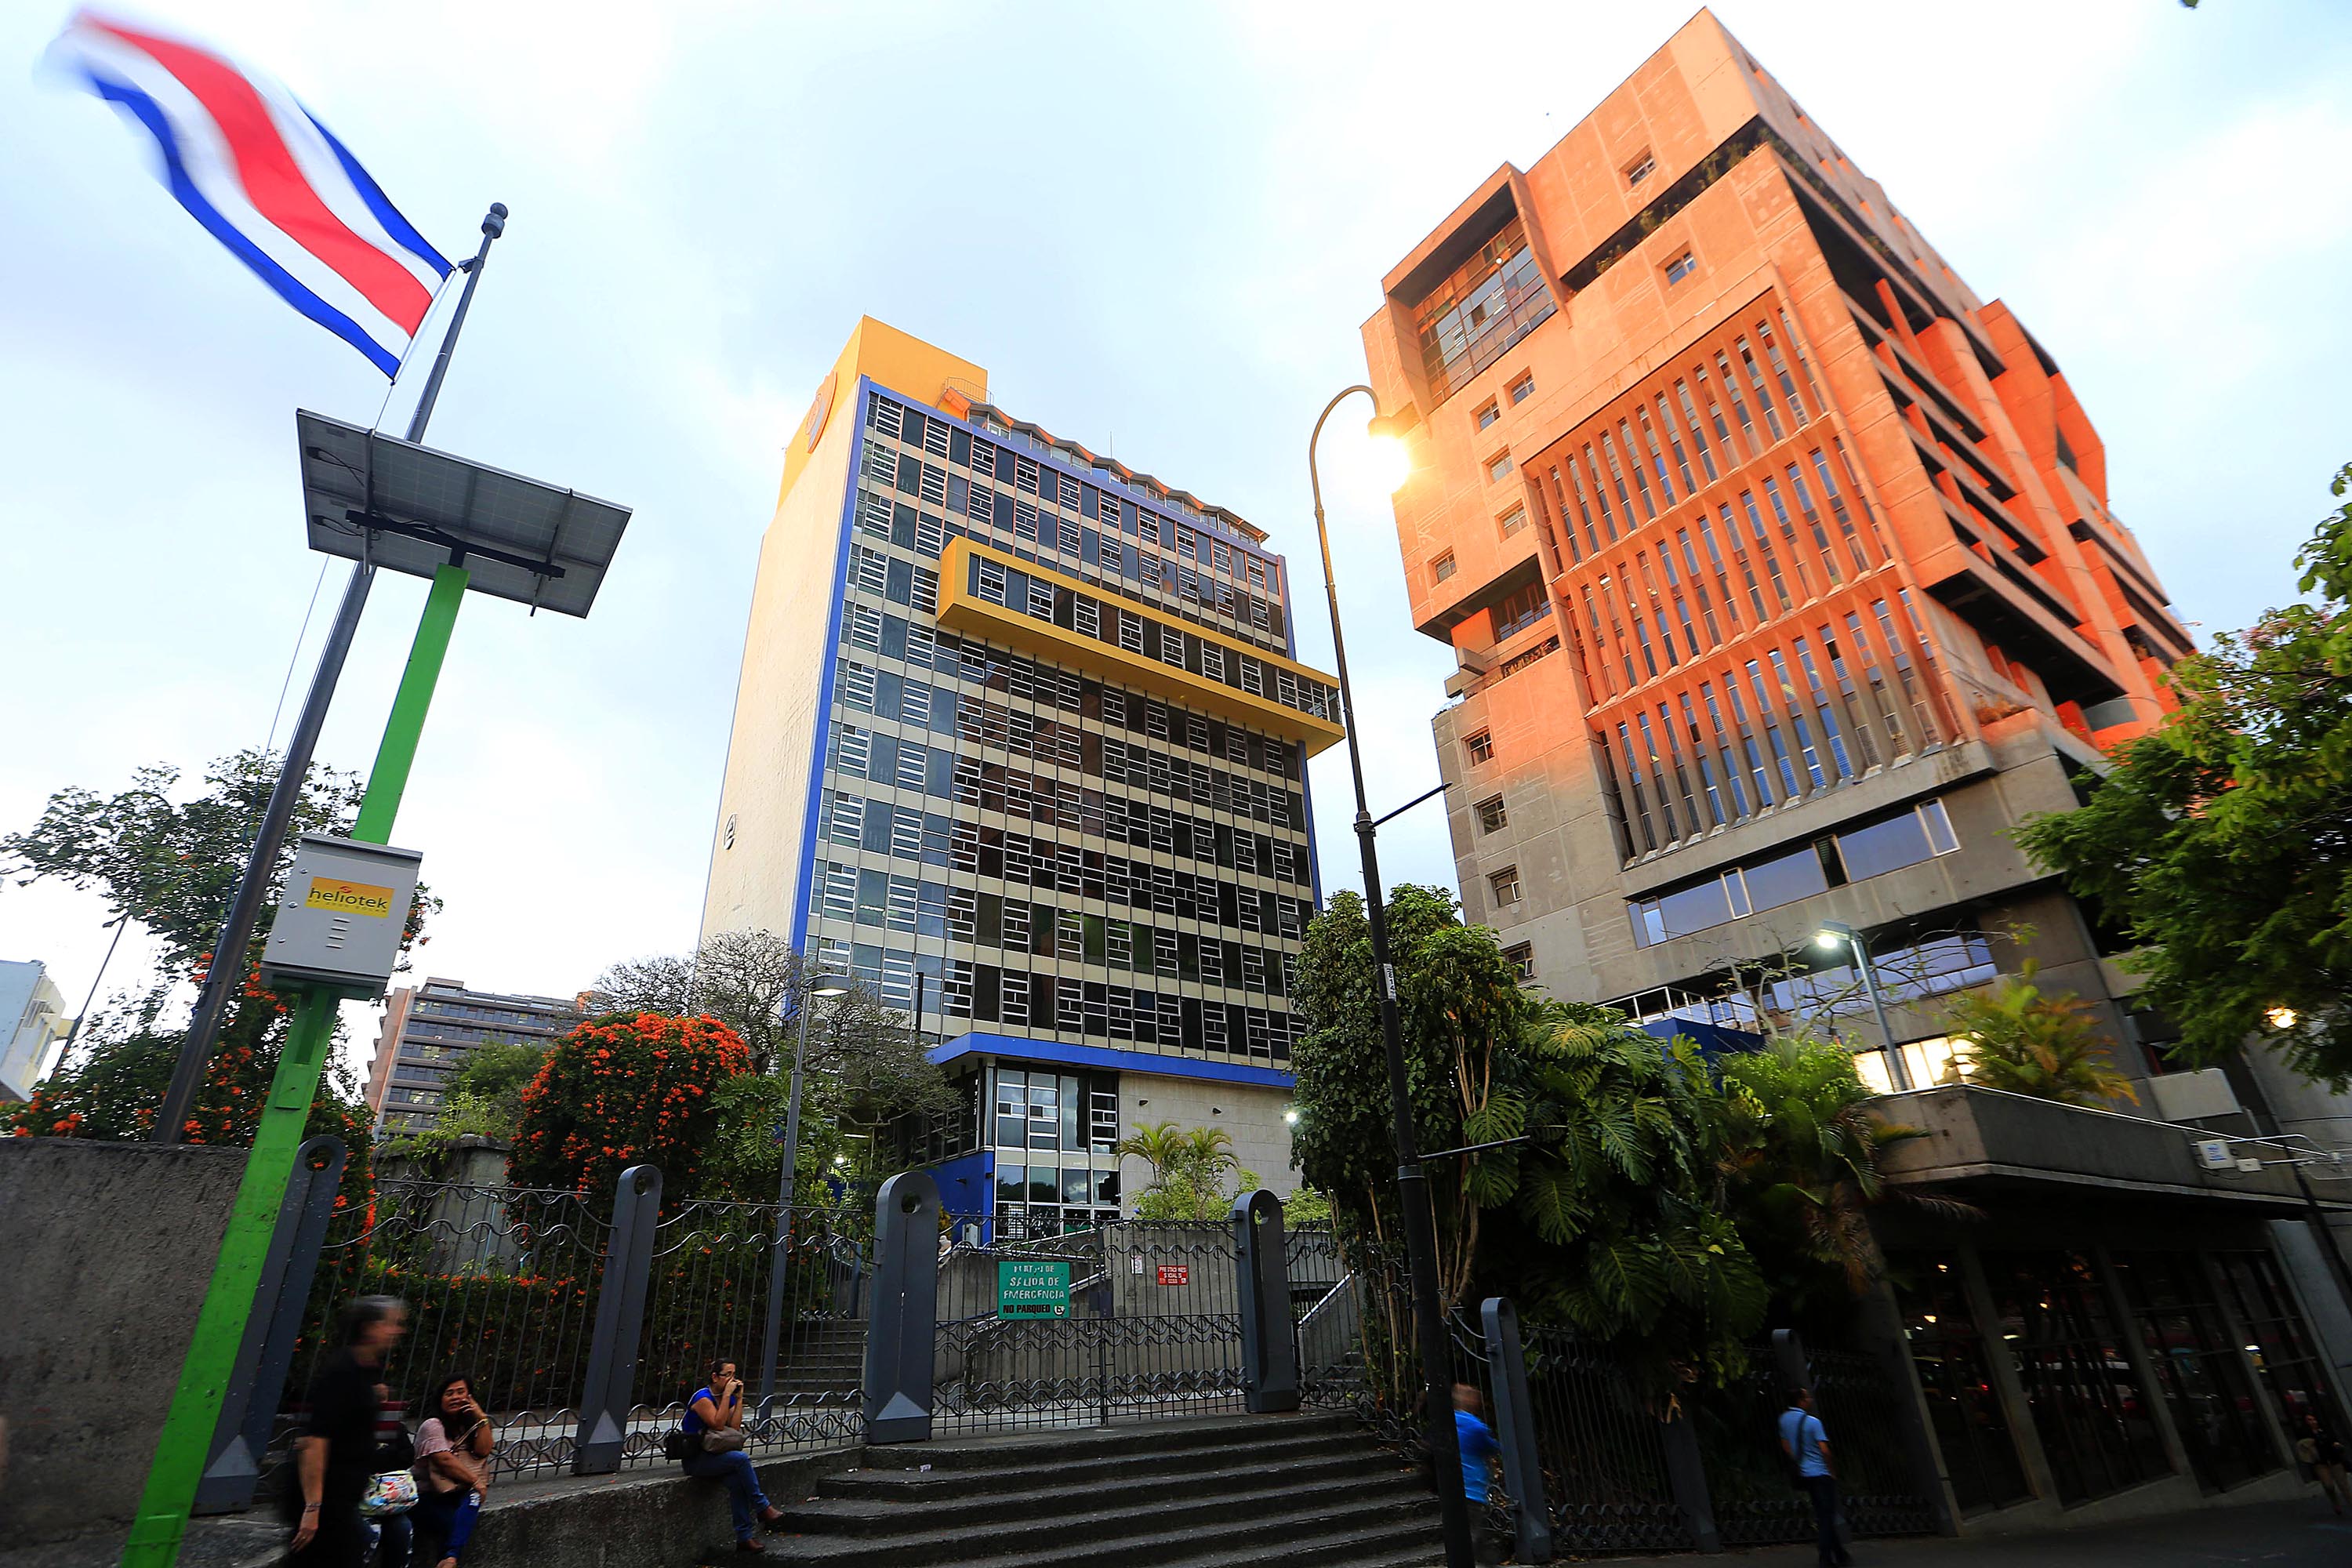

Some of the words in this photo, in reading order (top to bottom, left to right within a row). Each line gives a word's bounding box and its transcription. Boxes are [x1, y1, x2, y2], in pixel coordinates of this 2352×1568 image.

[308, 887, 388, 909] heliotek
[1010, 1276, 1045, 1287] SALIDA
[1047, 1277, 1059, 1286] DE
[1004, 1290, 1065, 1299] EMERGENCIA
[1003, 1305, 1014, 1313] NO
[1016, 1304, 1051, 1314] PARQUEO
